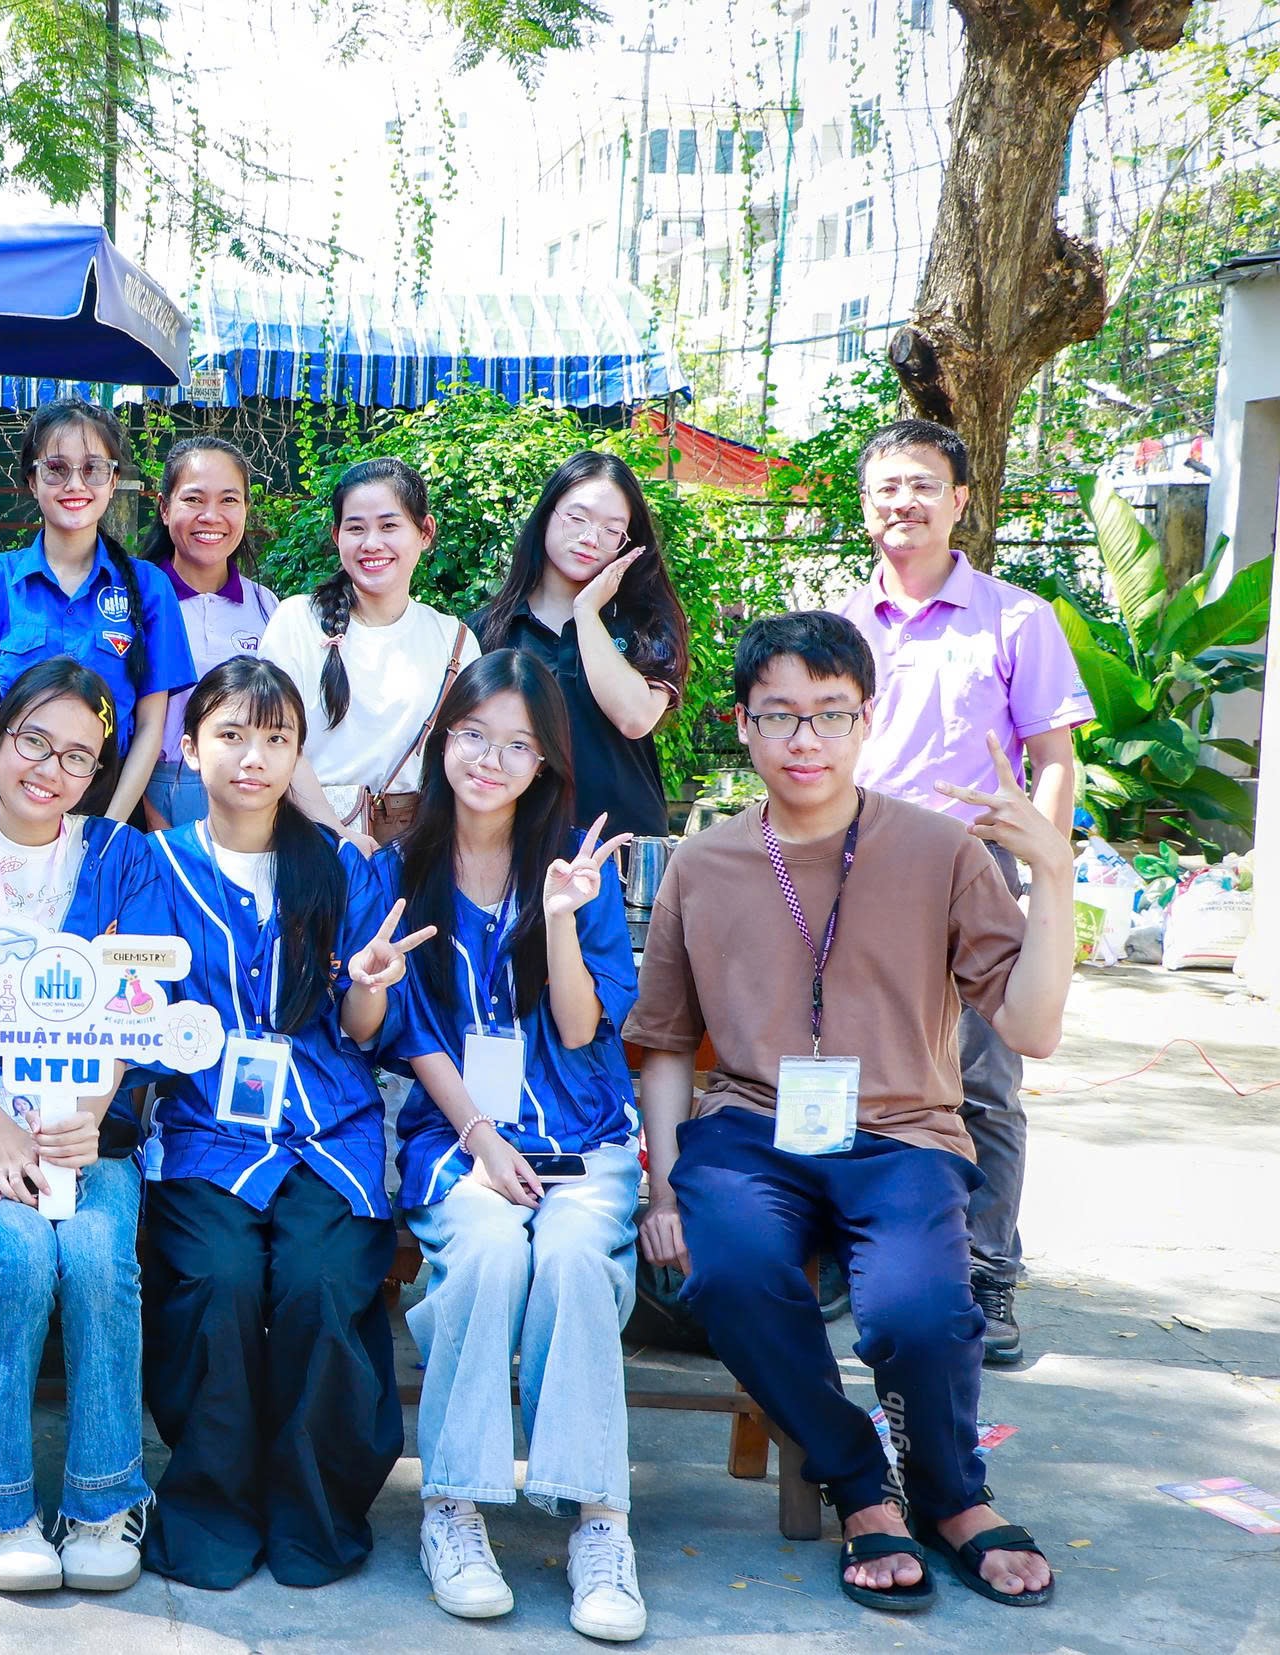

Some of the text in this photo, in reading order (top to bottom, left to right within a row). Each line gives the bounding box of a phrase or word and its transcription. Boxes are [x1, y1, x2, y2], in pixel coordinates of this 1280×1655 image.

[113, 952, 167, 962] CHEMISTRY
[39, 984, 78, 1000] NTU
[66, 1024, 114, 1046] HÓA
[120, 1033, 164, 1051] HỌC
[14, 1057, 100, 1083] NTU
